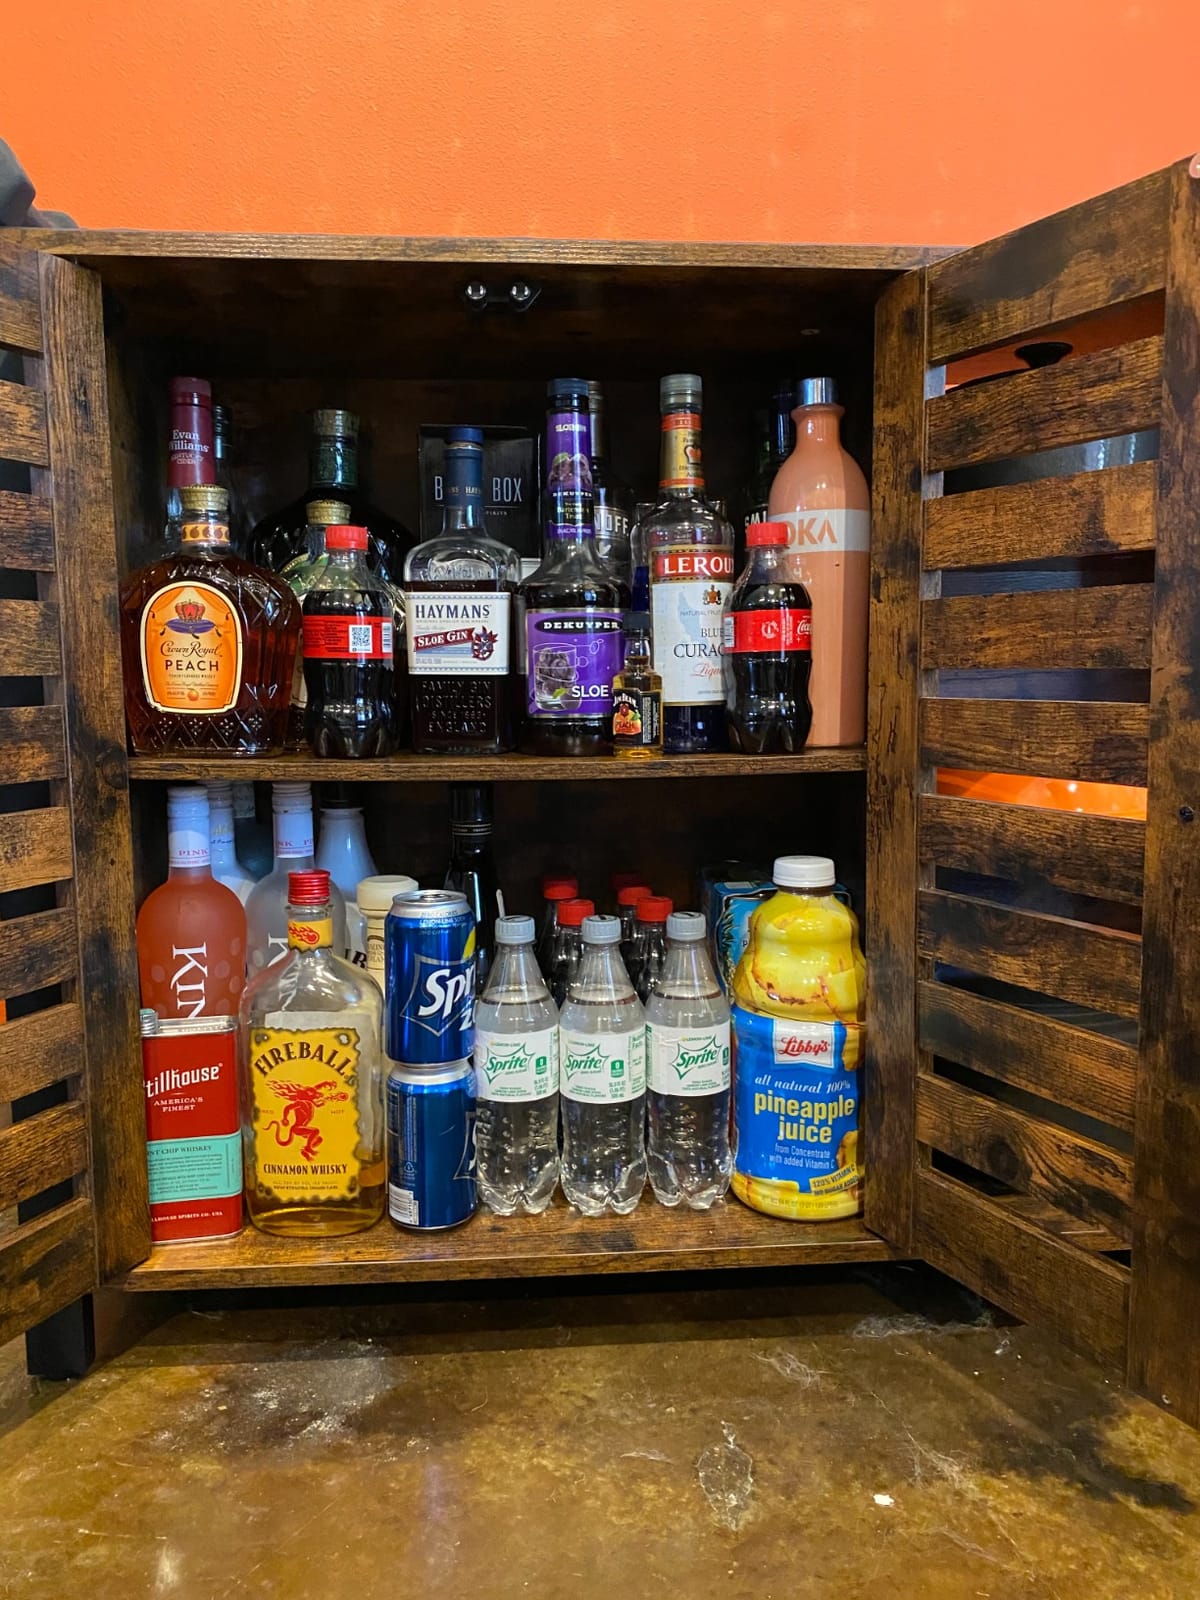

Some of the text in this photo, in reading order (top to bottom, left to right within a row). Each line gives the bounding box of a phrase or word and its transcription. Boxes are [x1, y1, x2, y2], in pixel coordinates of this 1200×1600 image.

[173, 429, 199, 440] Evan
[493, 477, 521, 502] BOX
[416, 604, 490, 619] HAYMANS
[543, 621, 620, 630] DEKUYPER
[418, 630, 468, 648] SLOE GIN
[160, 641, 223, 658] Crown Royal
[165, 660, 219, 671] PEACH
[571, 685, 609, 698] SLOE
[779, 1035, 830, 1057] Libby's
[254, 1041, 352, 1078] FIREBALL
[486, 1055, 528, 1073] Sprite
[566, 1054, 602, 1072] Sprite
[676, 1048, 718, 1069] Sprite
[145, 1065, 220, 1099] tillhouse
[754, 1074, 771, 1086] all
[774, 1080, 822, 1094] natural
[153, 1096, 204, 1107] AMERICA'S
[162, 1104, 196, 1113] FINEST
[755, 1089, 855, 1126] pineapple
[777, 1115, 832, 1143] juice
[790, 1145, 831, 1159] Concentrate
[263, 1163, 348, 1175] CINNAMON WHISKY
[783, 1156, 804, 1168] added
[804, 1158, 830, 1170] Vitamin
